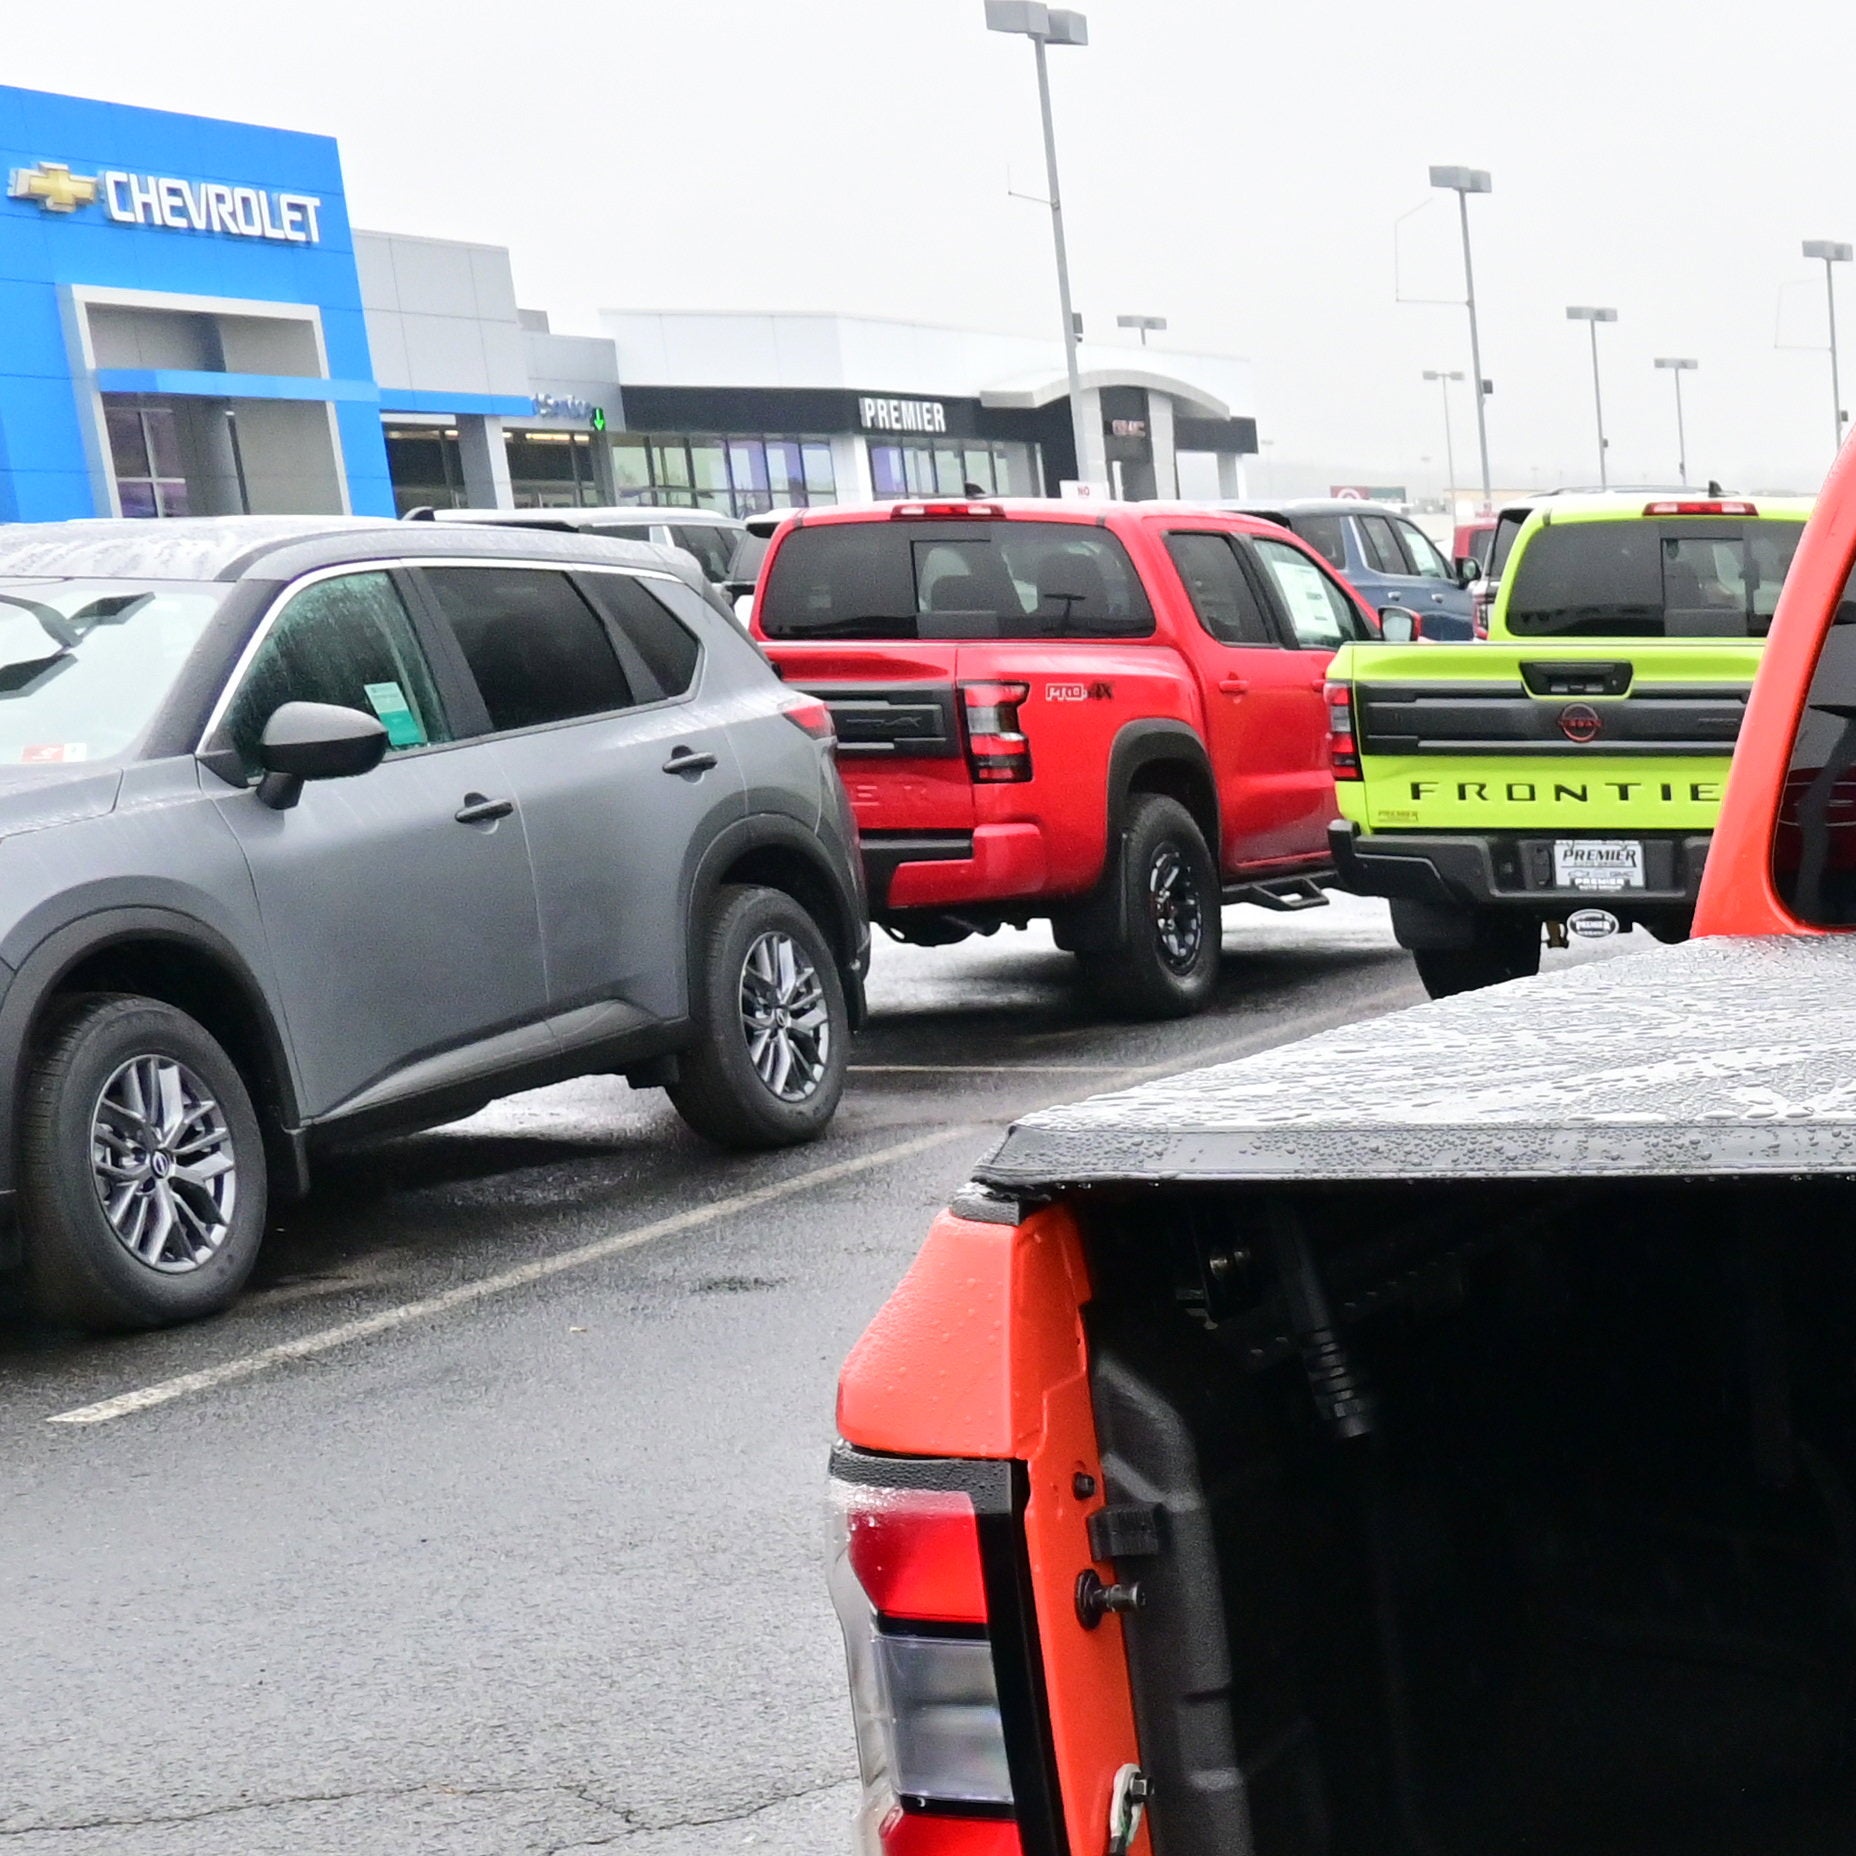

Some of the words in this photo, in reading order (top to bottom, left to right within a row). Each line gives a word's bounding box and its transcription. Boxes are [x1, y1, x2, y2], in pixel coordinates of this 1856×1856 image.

[105, 171, 320, 243] CHEVROLET
[862, 397, 946, 432] PREMIER
[1410, 781, 1721, 803] FRONTIE
[1562, 849, 1636, 867] PREMIER
